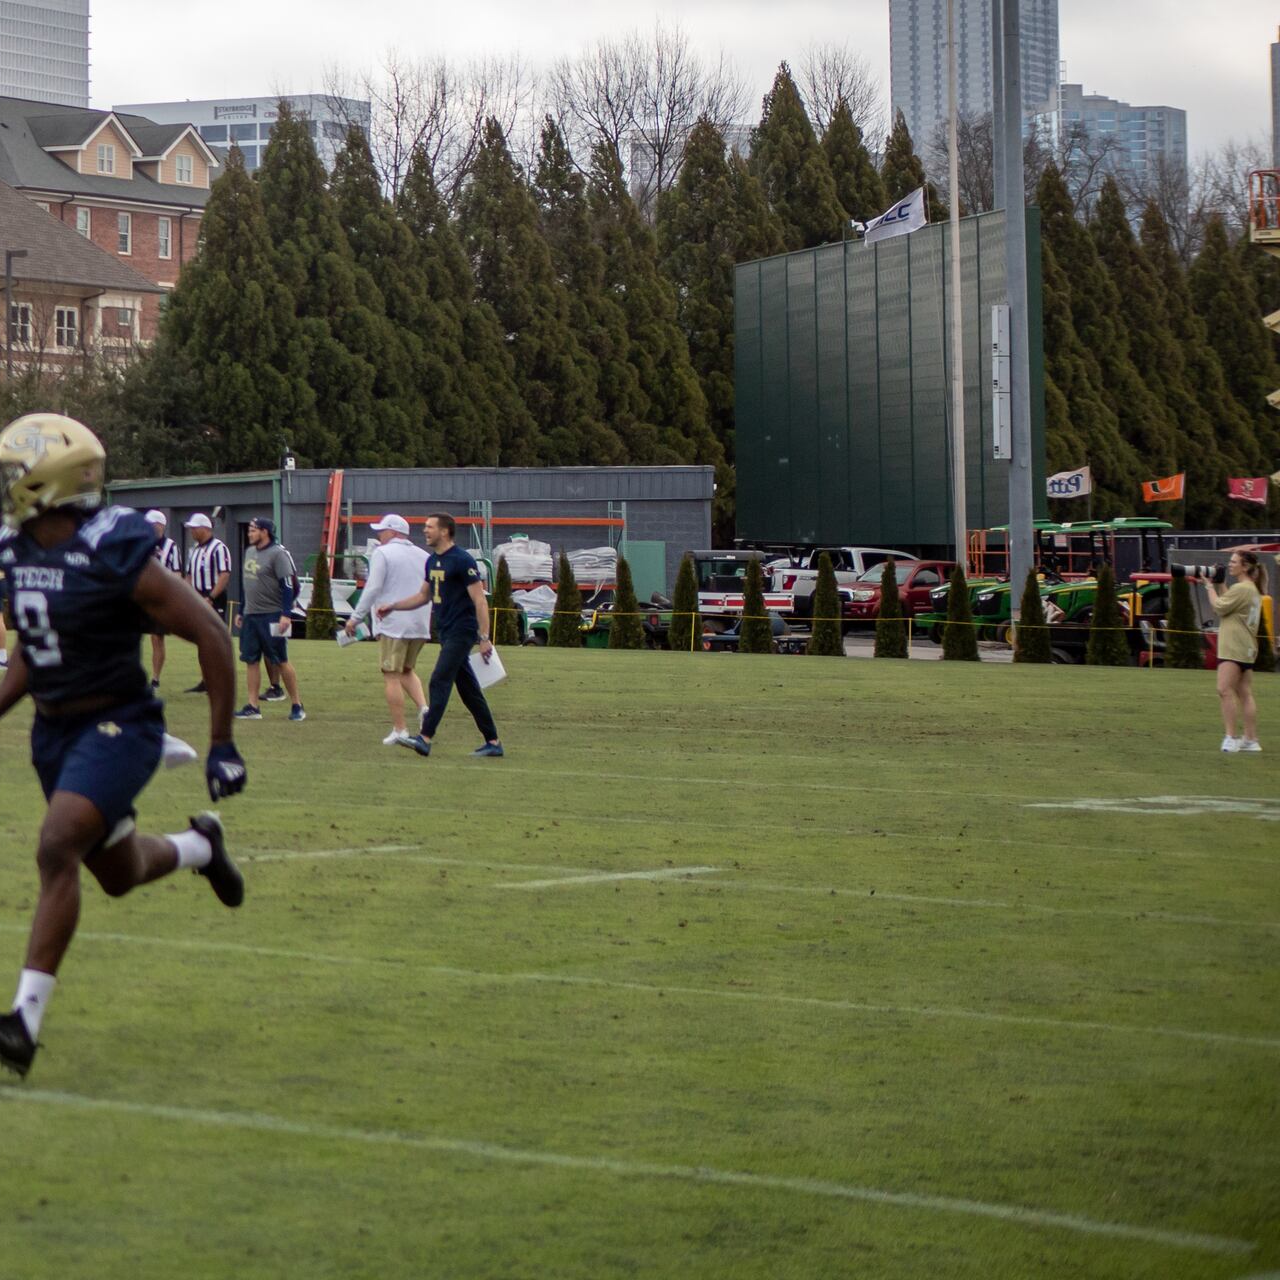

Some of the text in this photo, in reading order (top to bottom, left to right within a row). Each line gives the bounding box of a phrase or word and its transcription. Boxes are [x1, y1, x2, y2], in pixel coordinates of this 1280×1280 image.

[11, 566, 65, 591] TECH
[430, 569, 445, 604] T
[14, 589, 63, 668] 9
